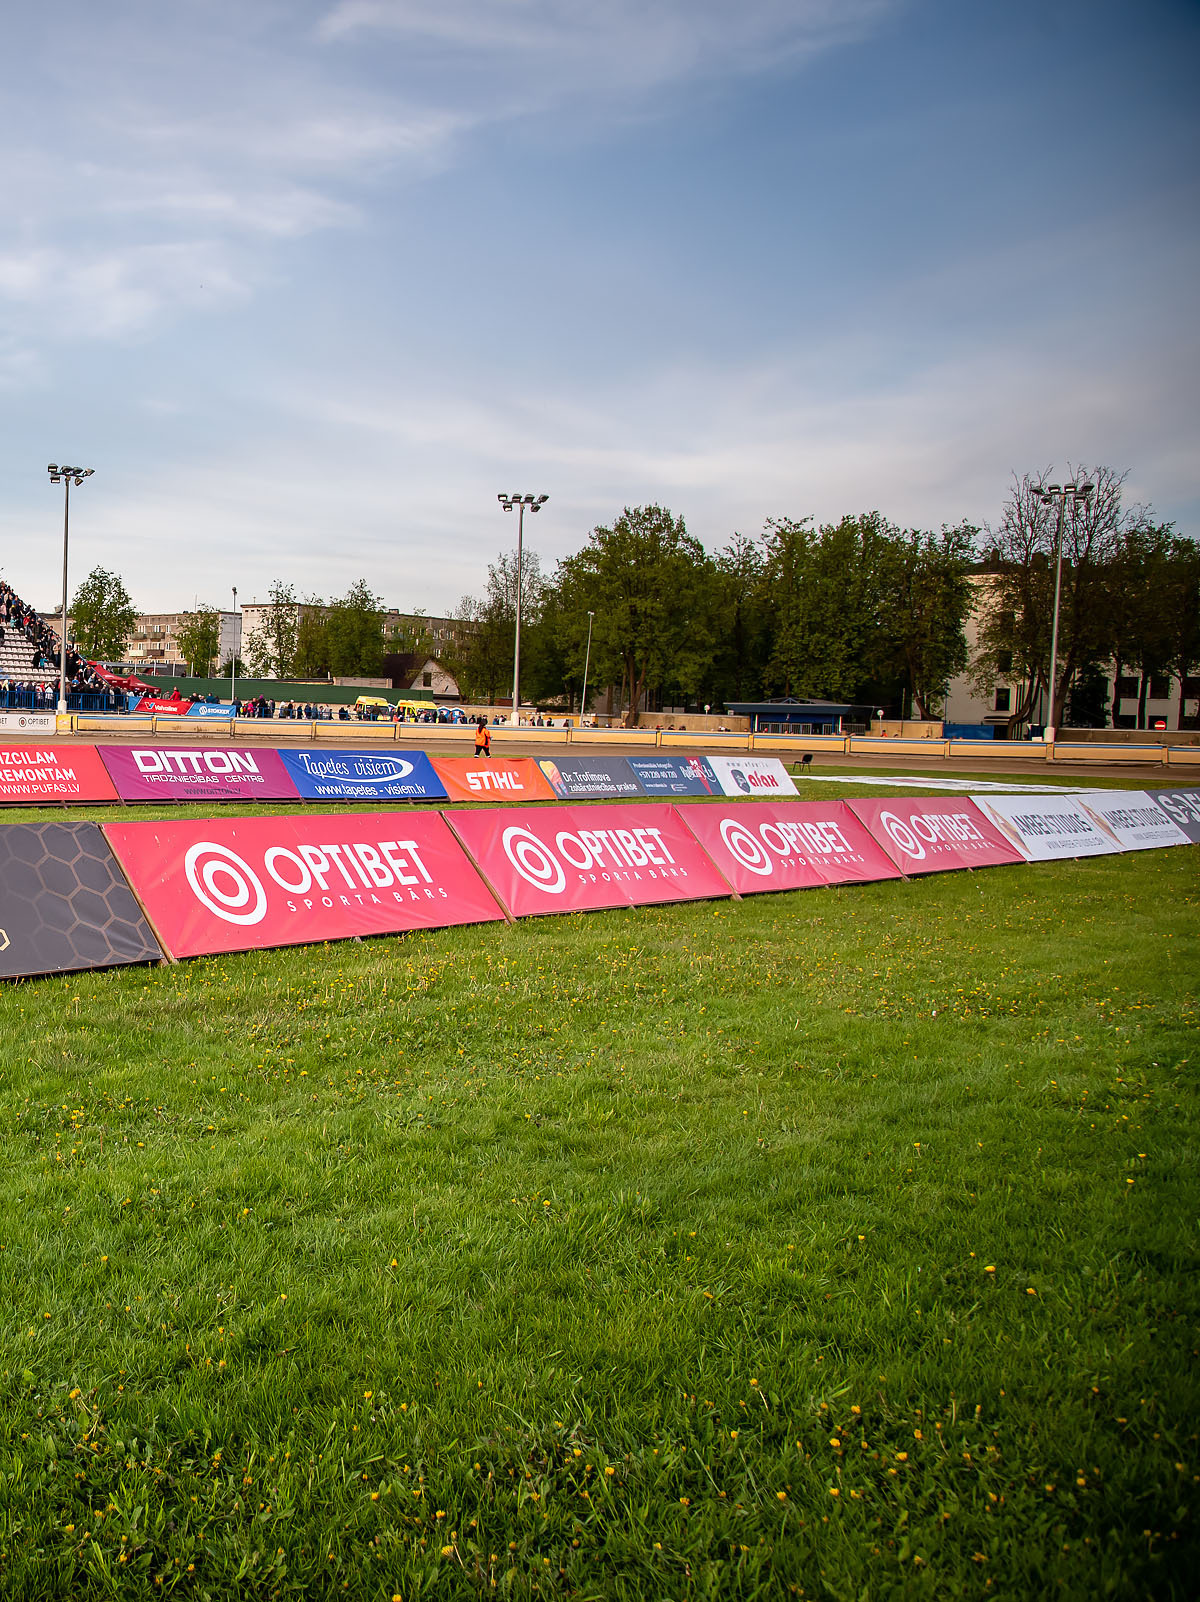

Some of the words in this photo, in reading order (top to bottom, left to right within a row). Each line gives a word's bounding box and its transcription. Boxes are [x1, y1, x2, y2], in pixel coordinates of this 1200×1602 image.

[155, 704, 178, 712] Valvoline
[131, 750, 260, 773] DITTON
[298, 753, 349, 778] Tapetes
[354, 758, 398, 776] visiem
[143, 774, 219, 783] TIRDZNIECĪBAS
[224, 775, 265, 783] CENTRS
[465, 771, 524, 790] STIHL
[561, 771, 576, 782] Dr.
[574, 771, 611, 782] Trofimova
[0, 784, 80, 794] WWW.PUFAS.LV
[616, 782, 638, 793] prakse
[909, 813, 985, 843] OPTIBET
[1011, 814, 1050, 836] AMBER
[1043, 813, 1093, 835] STUDIOS
[1101, 809, 1137, 829] AMBER
[1128, 807, 1170, 828] STUDIOS
[759, 821, 854, 856] OPTIBET
[555, 828, 676, 870] OPTIBET
[930, 844, 969, 854] SPORTA
[264, 840, 434, 894] OPTIBET
[780, 857, 830, 868] SPORTA
[833, 854, 865, 865] BĀRS
[578, 871, 642, 885] SPORTA
[649, 866, 688, 879] BĀRS
[287, 893, 381, 912] SPORTA
[394, 887, 448, 903] BĀRS
